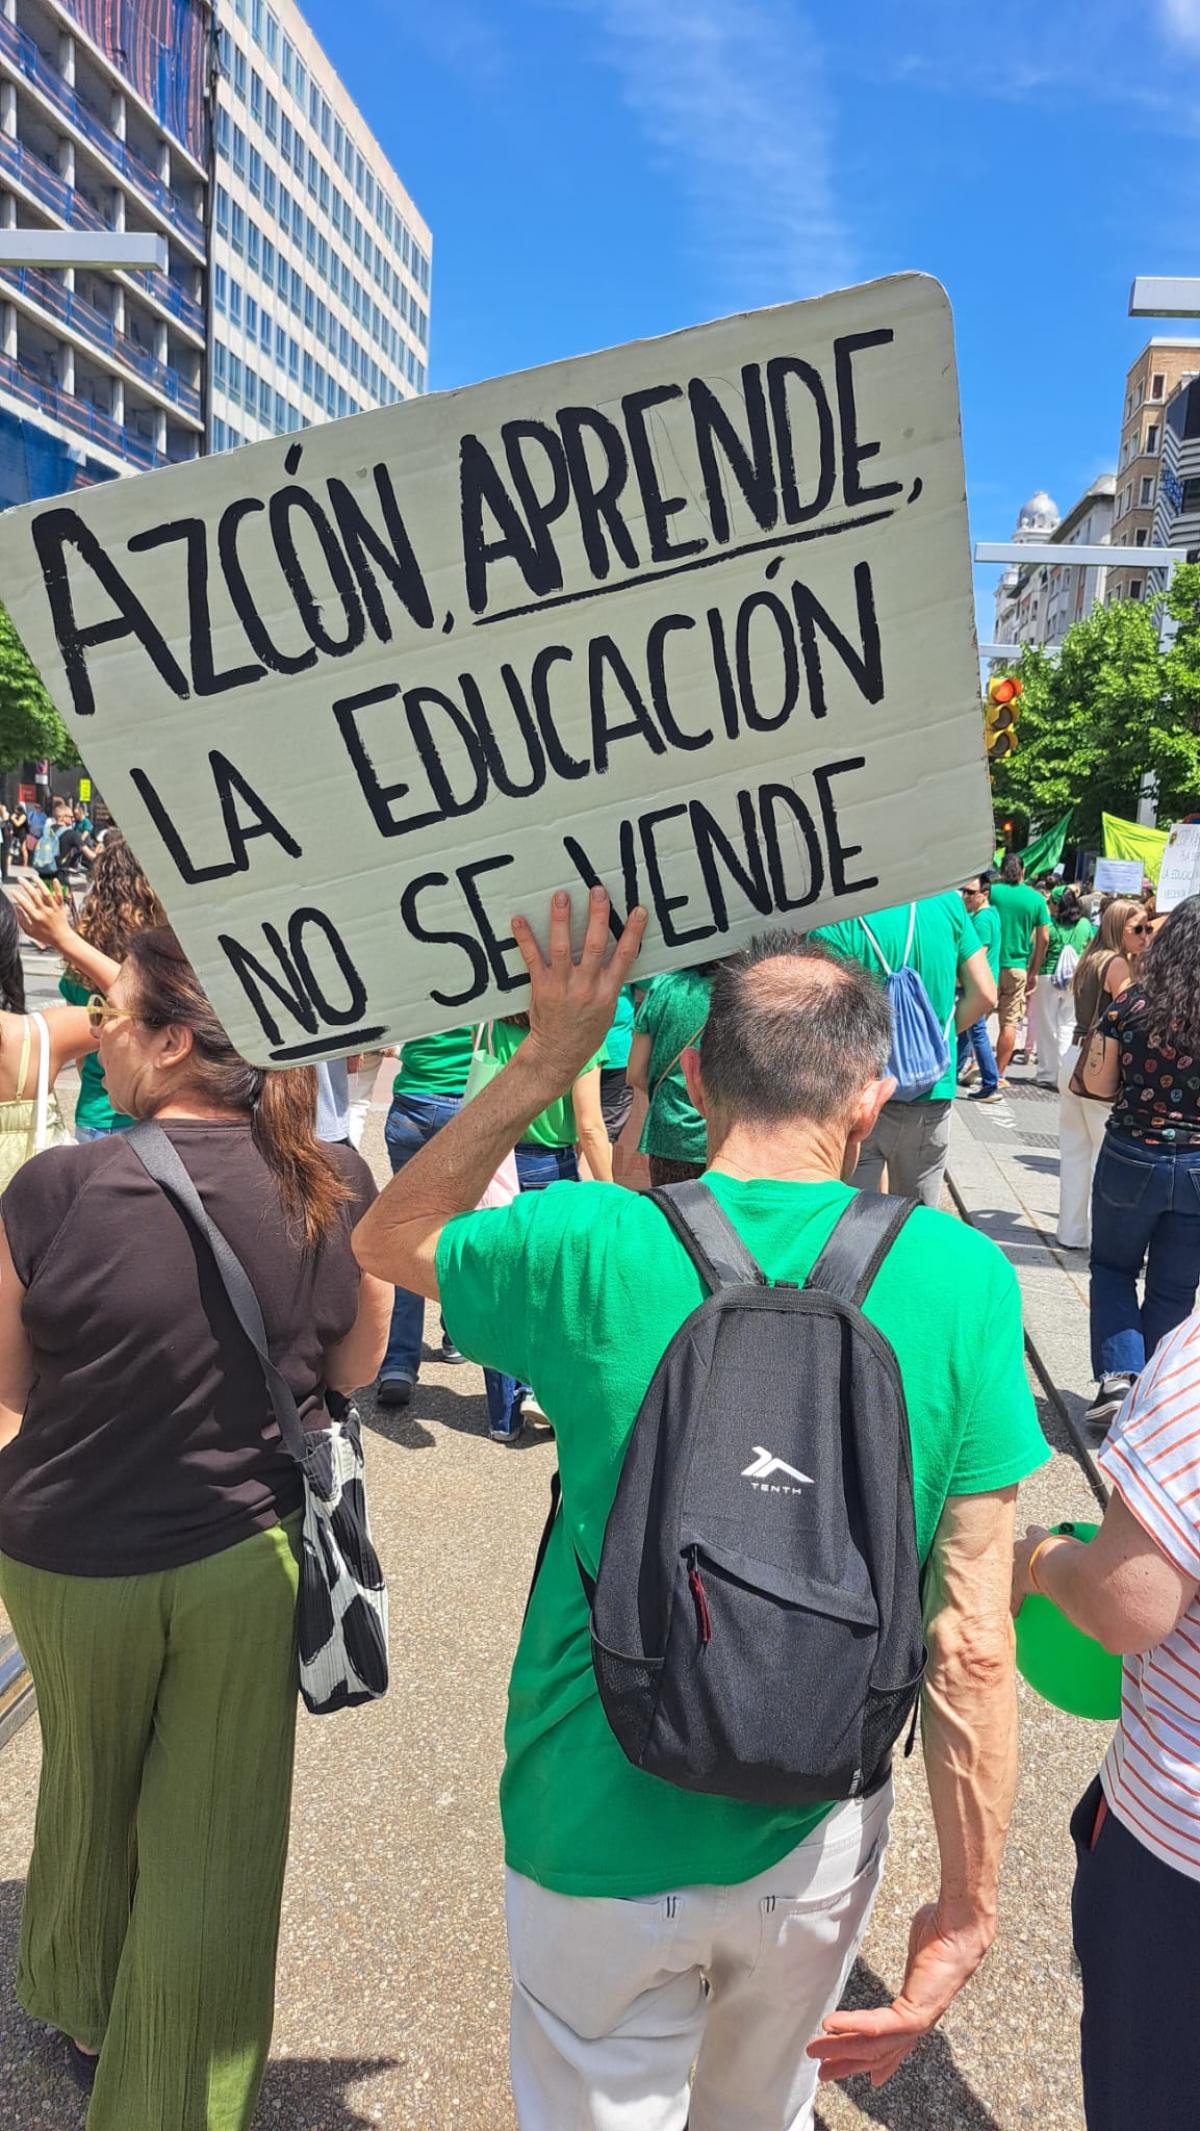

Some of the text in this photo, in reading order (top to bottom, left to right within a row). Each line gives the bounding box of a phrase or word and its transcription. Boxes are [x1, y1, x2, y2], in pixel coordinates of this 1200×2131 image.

[32, 329, 923, 716] AZCÓN, APRENDE,
[130, 556, 885, 885] LA EDUCACIÓN
[218, 757, 879, 1047] NO SE VENDE
[751, 1482, 802, 1495] TENTH
